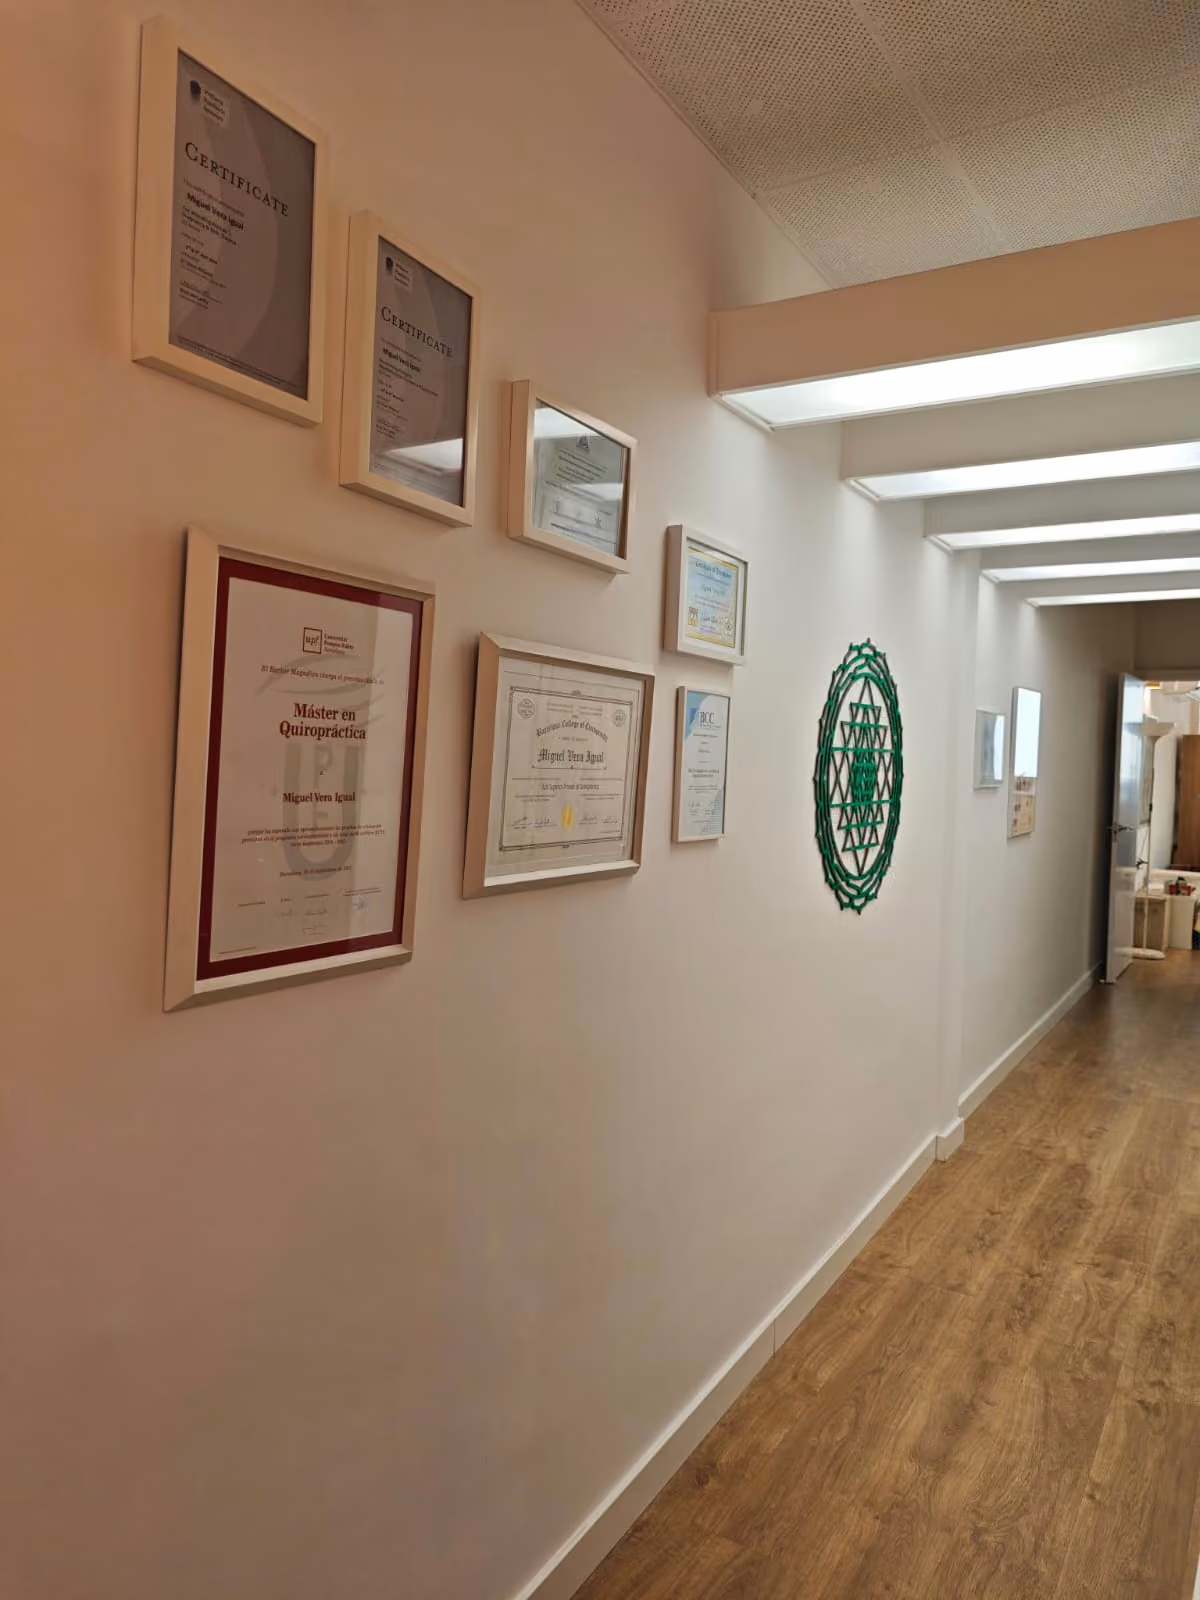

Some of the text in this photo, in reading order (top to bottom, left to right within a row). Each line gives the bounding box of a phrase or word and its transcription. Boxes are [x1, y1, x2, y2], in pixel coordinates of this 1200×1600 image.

[185, 142, 288, 217] CERTIFICATE
[381, 306, 453, 358] CERTIFICATE
[294, 703, 356, 721] Máster en
[280, 720, 366, 740] Quiropráctica
[537, 748, 604, 765] Miguel Vera Igual
[283, 792, 356, 805] Miguel Vera Igual
